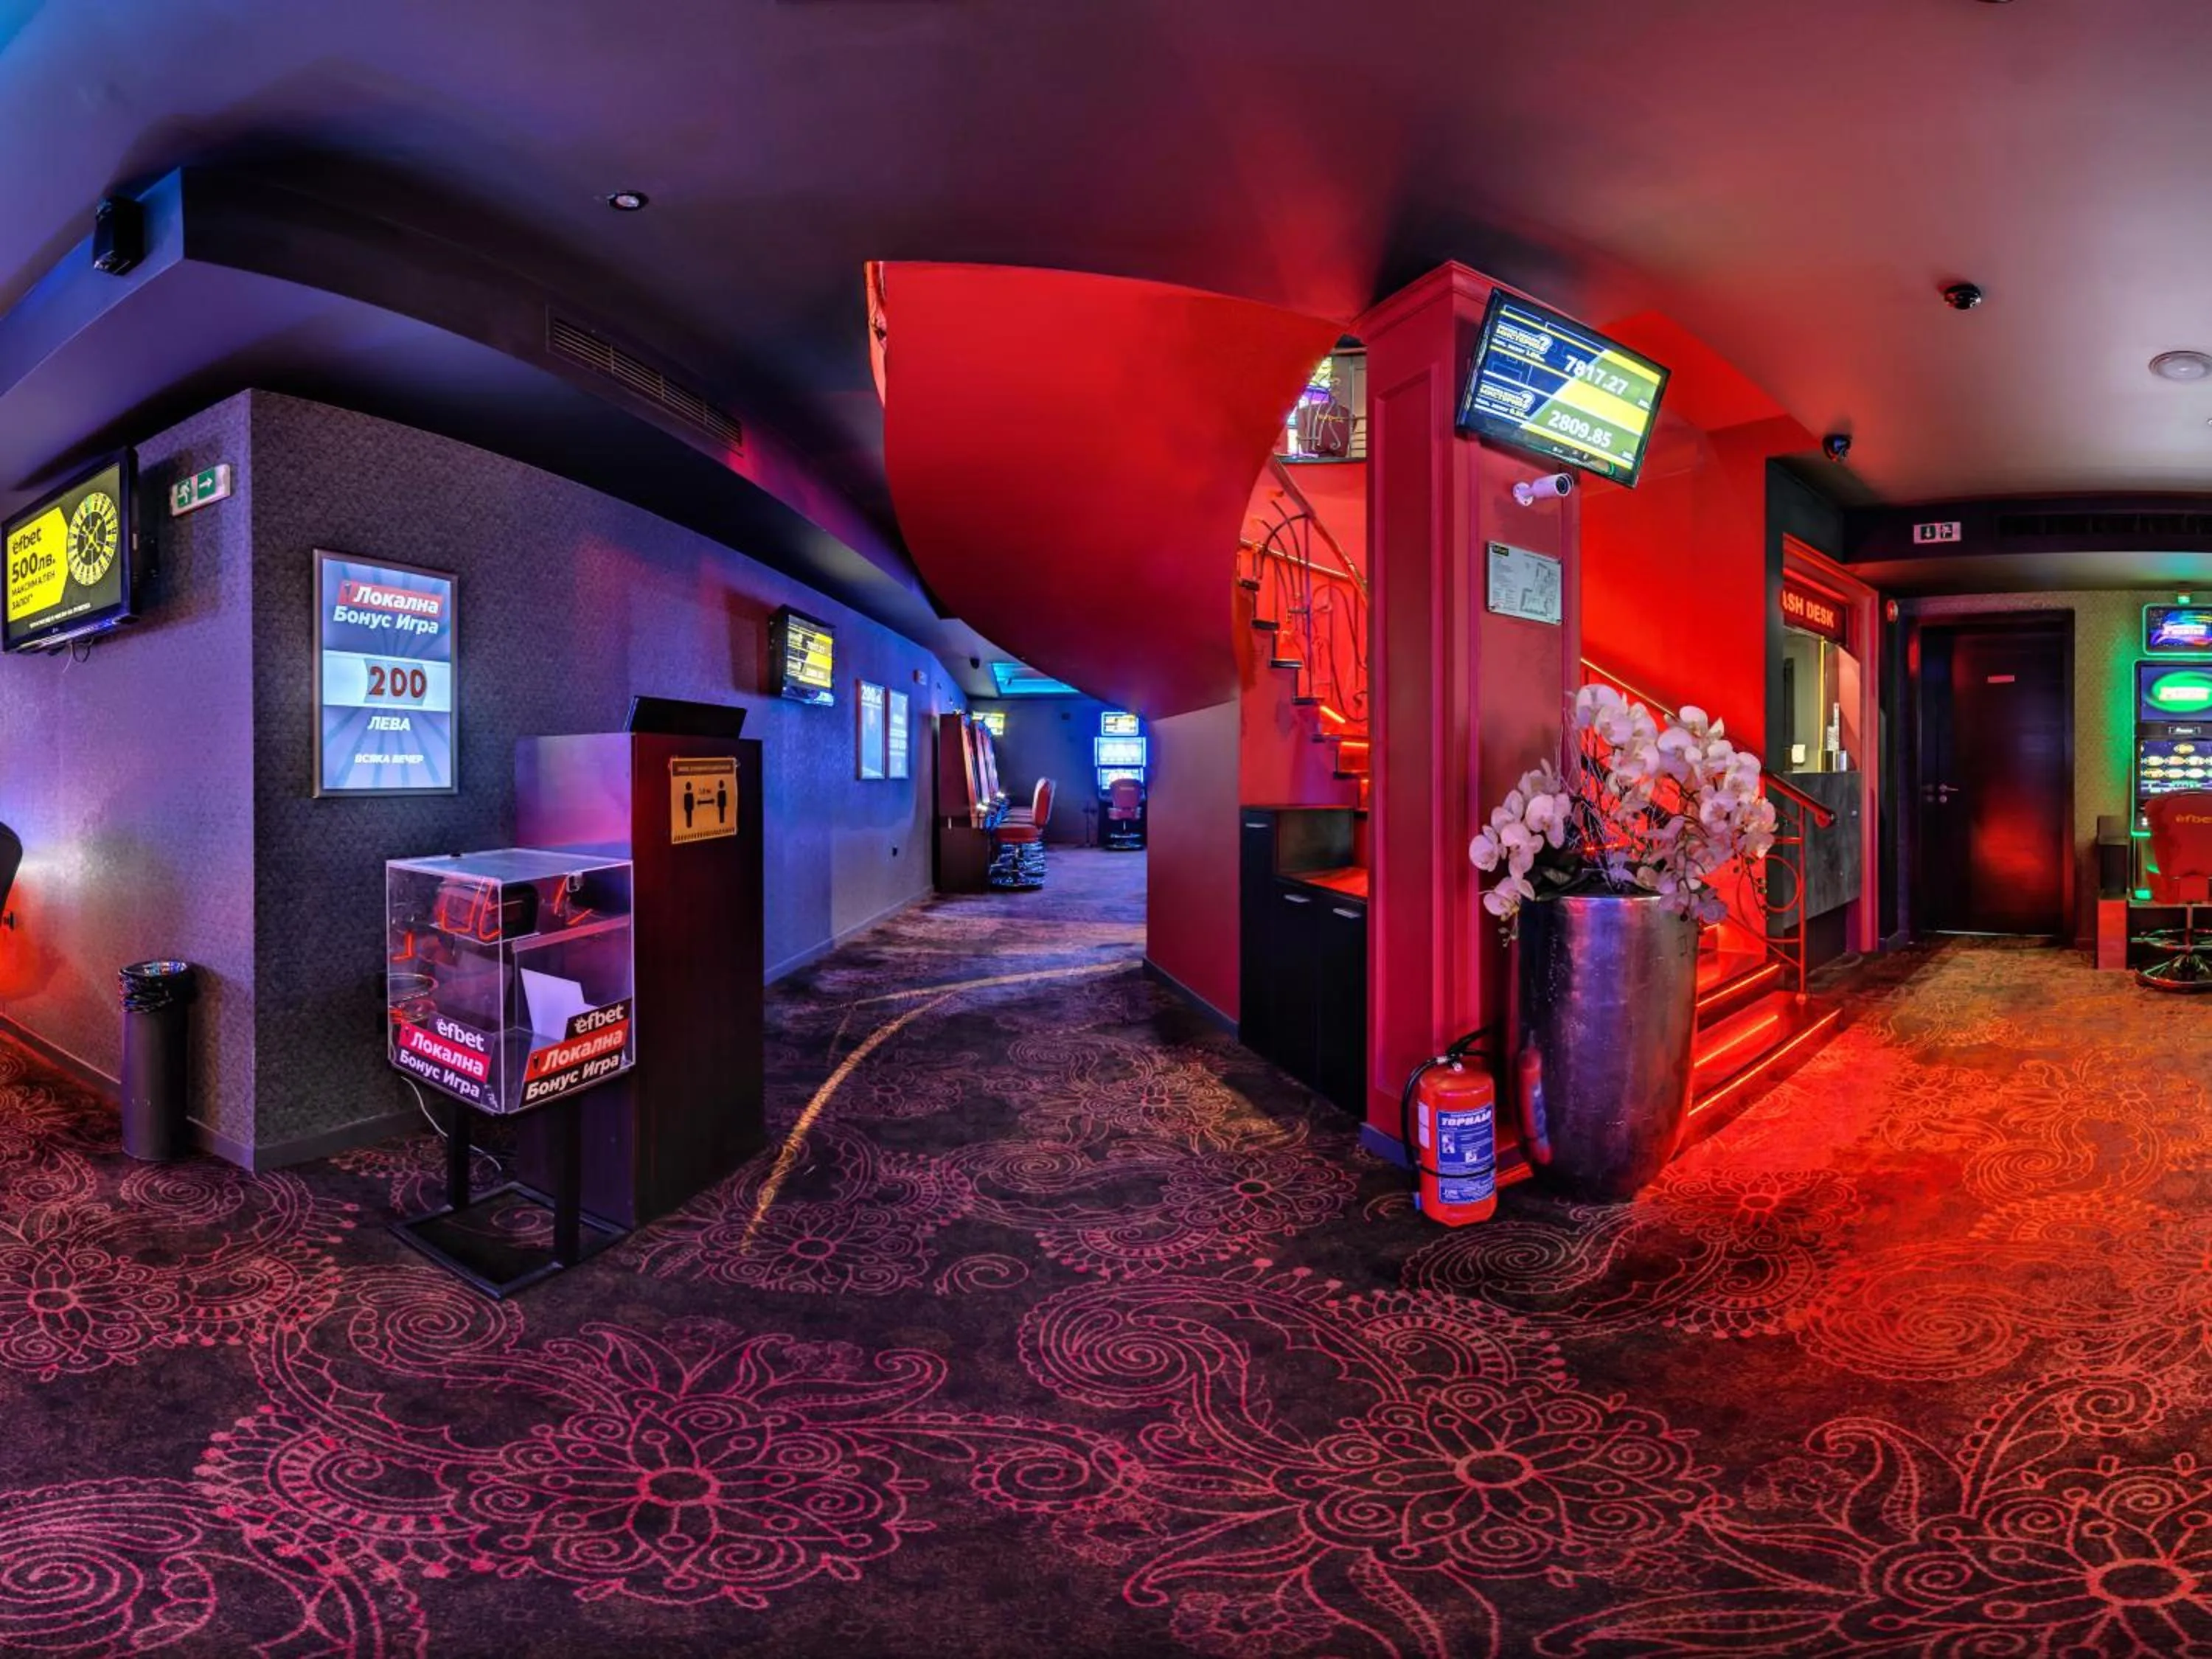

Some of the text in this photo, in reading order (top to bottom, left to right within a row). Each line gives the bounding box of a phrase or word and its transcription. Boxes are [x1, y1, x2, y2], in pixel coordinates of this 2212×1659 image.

[12, 527, 42, 554] efbet
[352, 585, 439, 614] Локална
[1806, 601, 1834, 628] DESK
[333, 605, 439, 634] Бонус Игра
[368, 666, 428, 698] 200
[367, 716, 411, 731] ЛЕВА
[355, 754, 424, 764] ВСЯКА ВЕЧЕР
[574, 1004, 625, 1034] efbet
[437, 1018, 484, 1051] efbet
[411, 1032, 484, 1077] Локална
[540, 1029, 623, 1072] Локална
[400, 1049, 479, 1098] Бонус Игра
[526, 1054, 619, 1101] Бонус Игра
